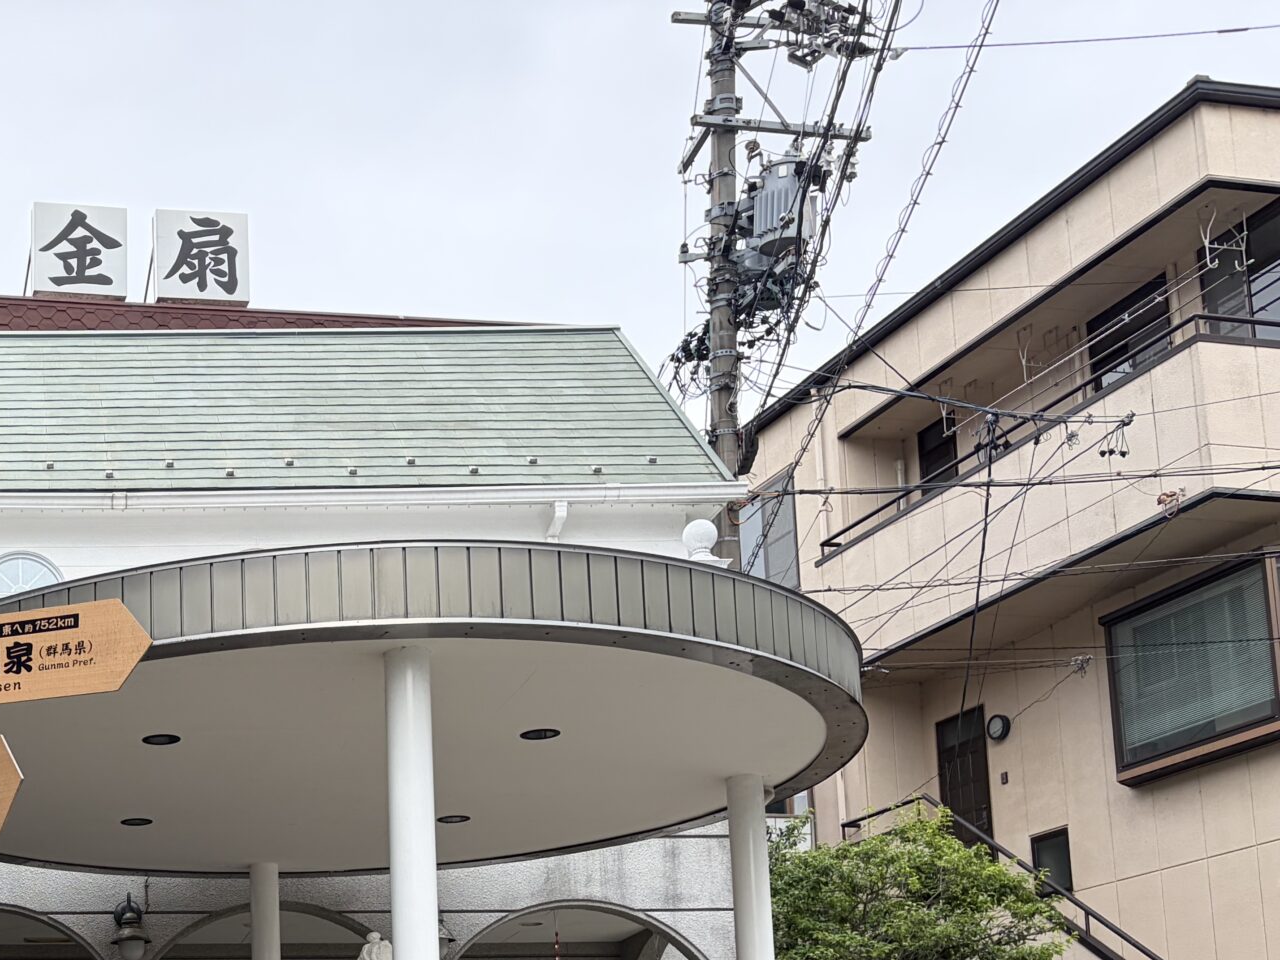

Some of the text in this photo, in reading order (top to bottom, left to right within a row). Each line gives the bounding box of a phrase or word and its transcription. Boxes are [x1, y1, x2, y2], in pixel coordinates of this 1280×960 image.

[39, 209, 238, 295] 金扇
[38, 657, 96, 672] Gunma Pref.
